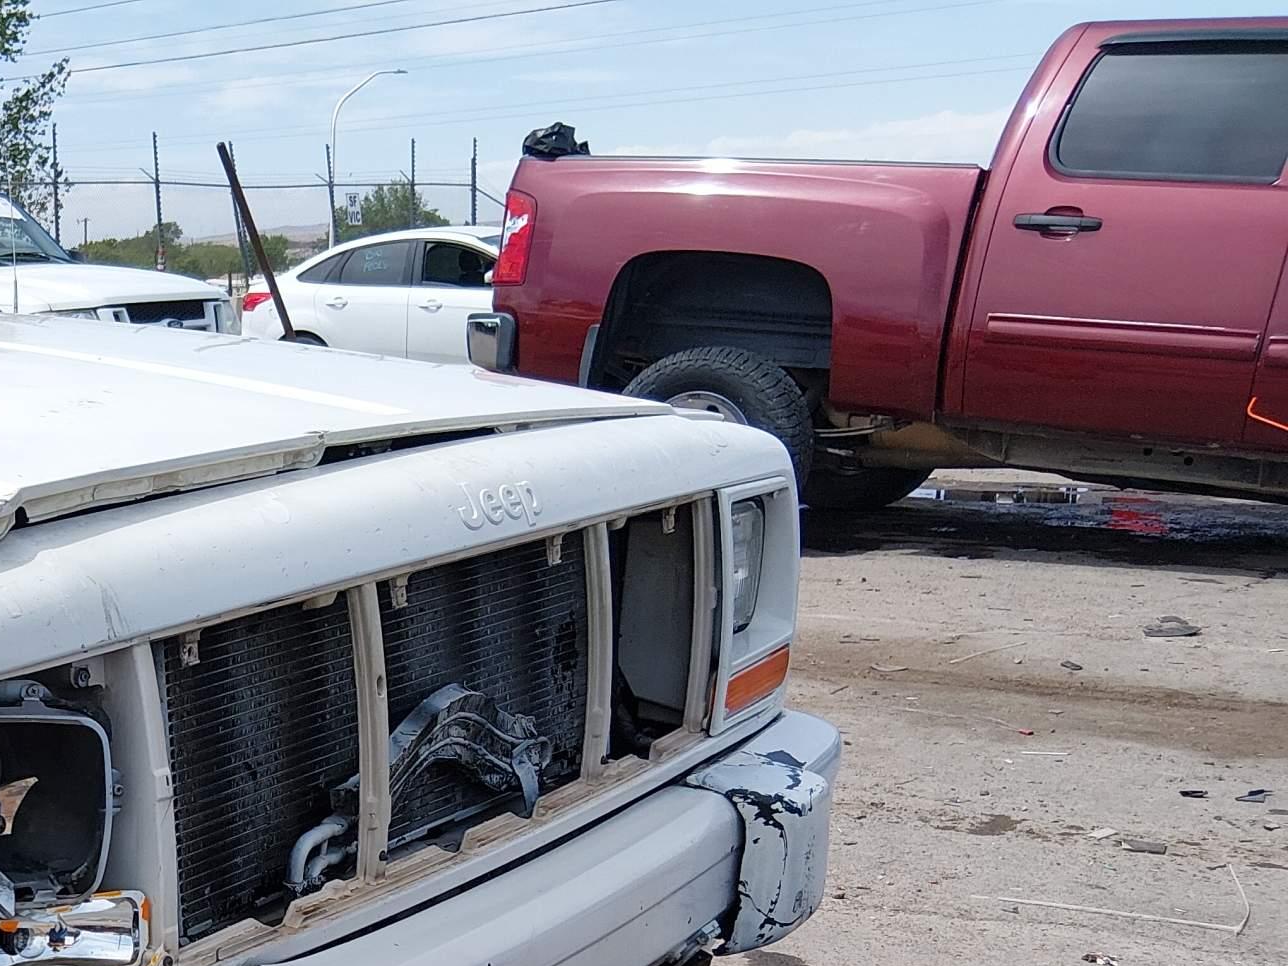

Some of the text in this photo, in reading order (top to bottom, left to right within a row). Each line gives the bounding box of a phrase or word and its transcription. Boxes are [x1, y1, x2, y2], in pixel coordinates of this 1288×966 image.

[348, 195, 357, 208] SF
[348, 210, 361, 224] VIC
[456, 481, 543, 531] Jeep
